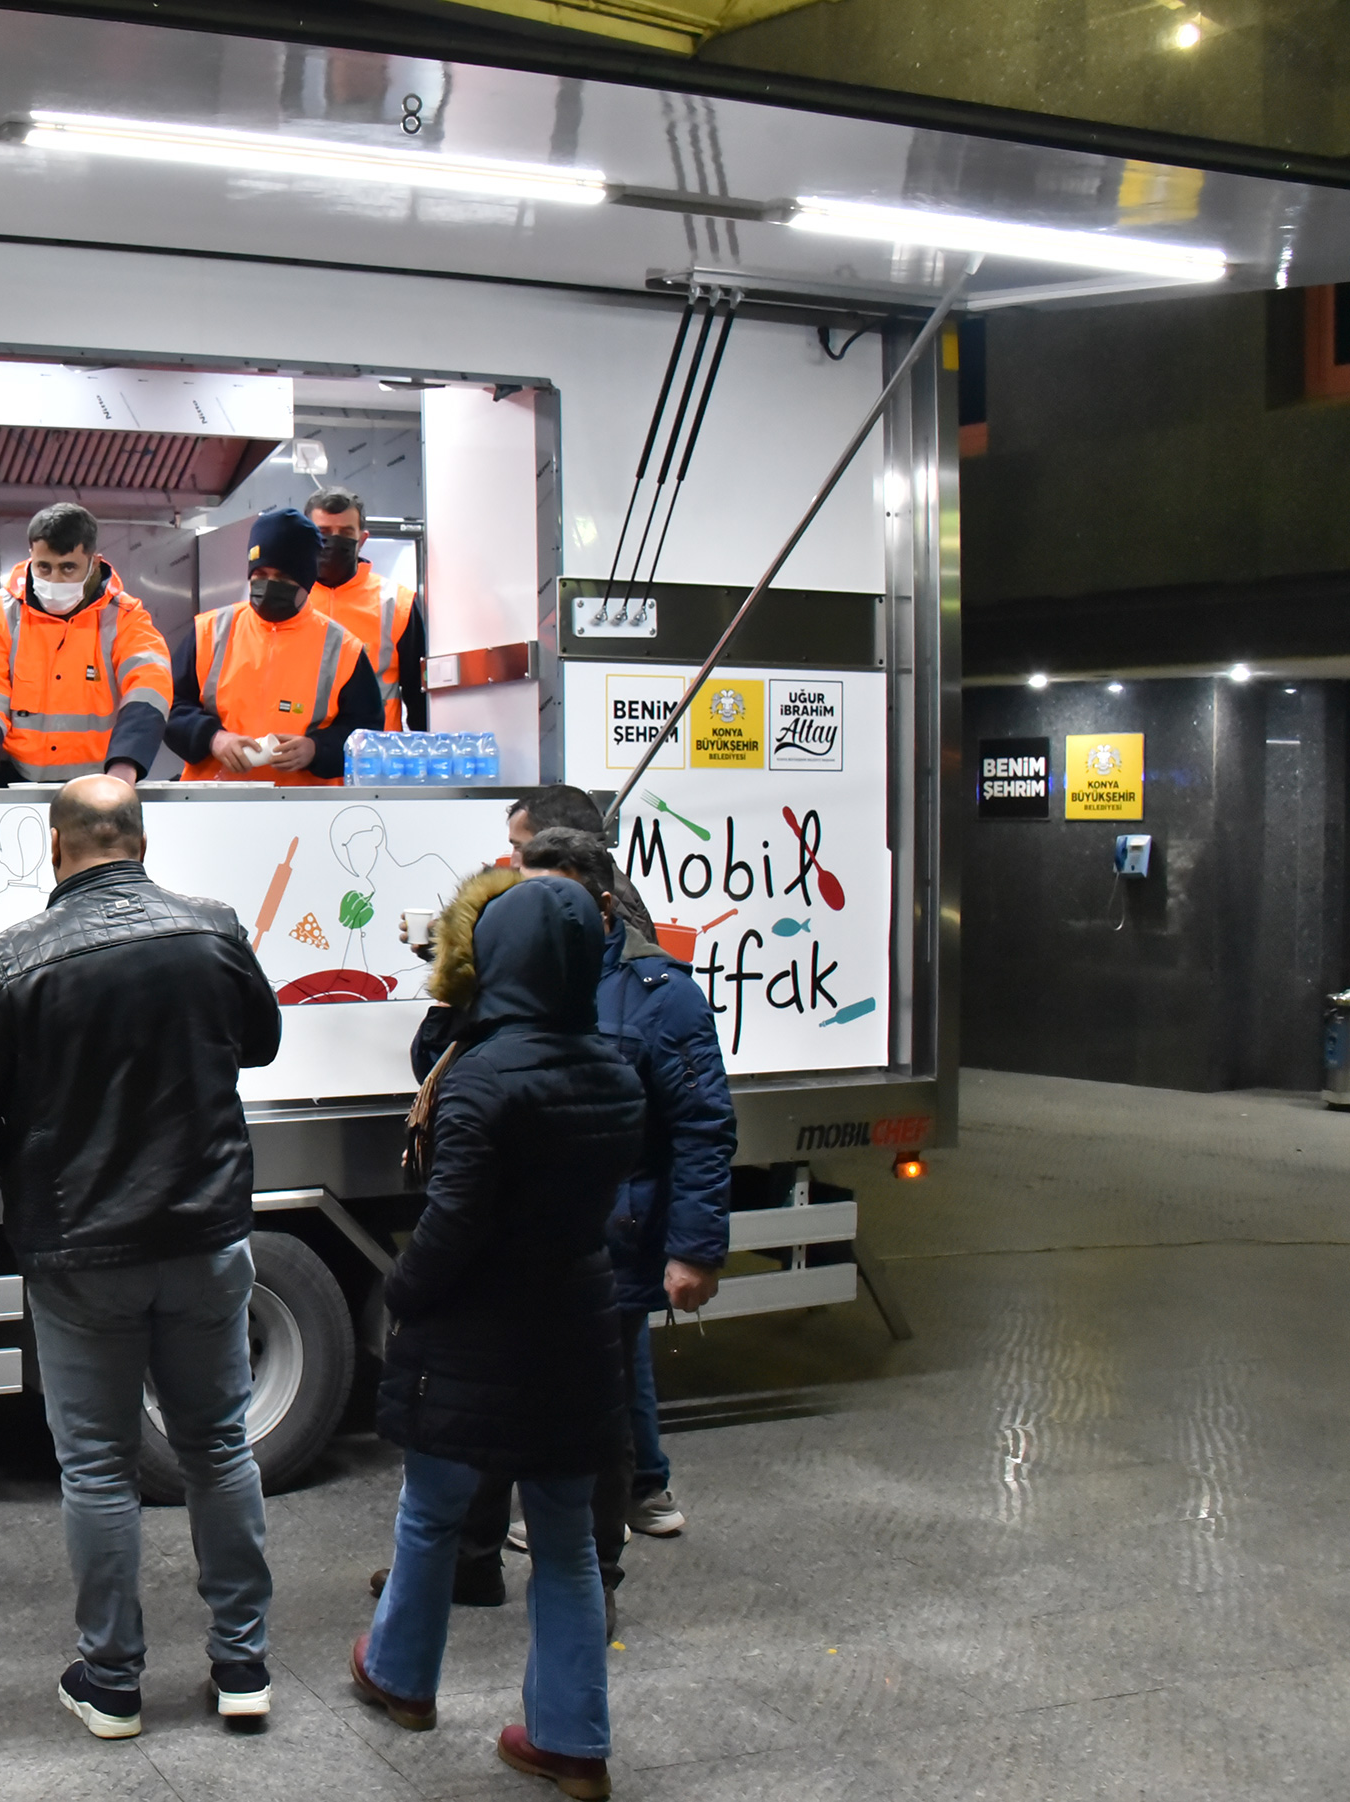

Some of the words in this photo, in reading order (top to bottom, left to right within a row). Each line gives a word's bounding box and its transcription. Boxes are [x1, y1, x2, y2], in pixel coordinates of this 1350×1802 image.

[789, 688, 825, 704] UĞUR
[613, 725, 679, 745] ŞEHRM
[711, 728, 743, 737] KONYA
[774, 717, 838, 756] Altay
[696, 738, 759, 752] BÜYÜKŞEHİR
[1088, 781, 1119, 790] KONYA
[1071, 790, 1136, 803] BÜYÜKŞEHİR
[625, 809, 821, 907] Mobil
[695, 928, 838, 1055] tfak
